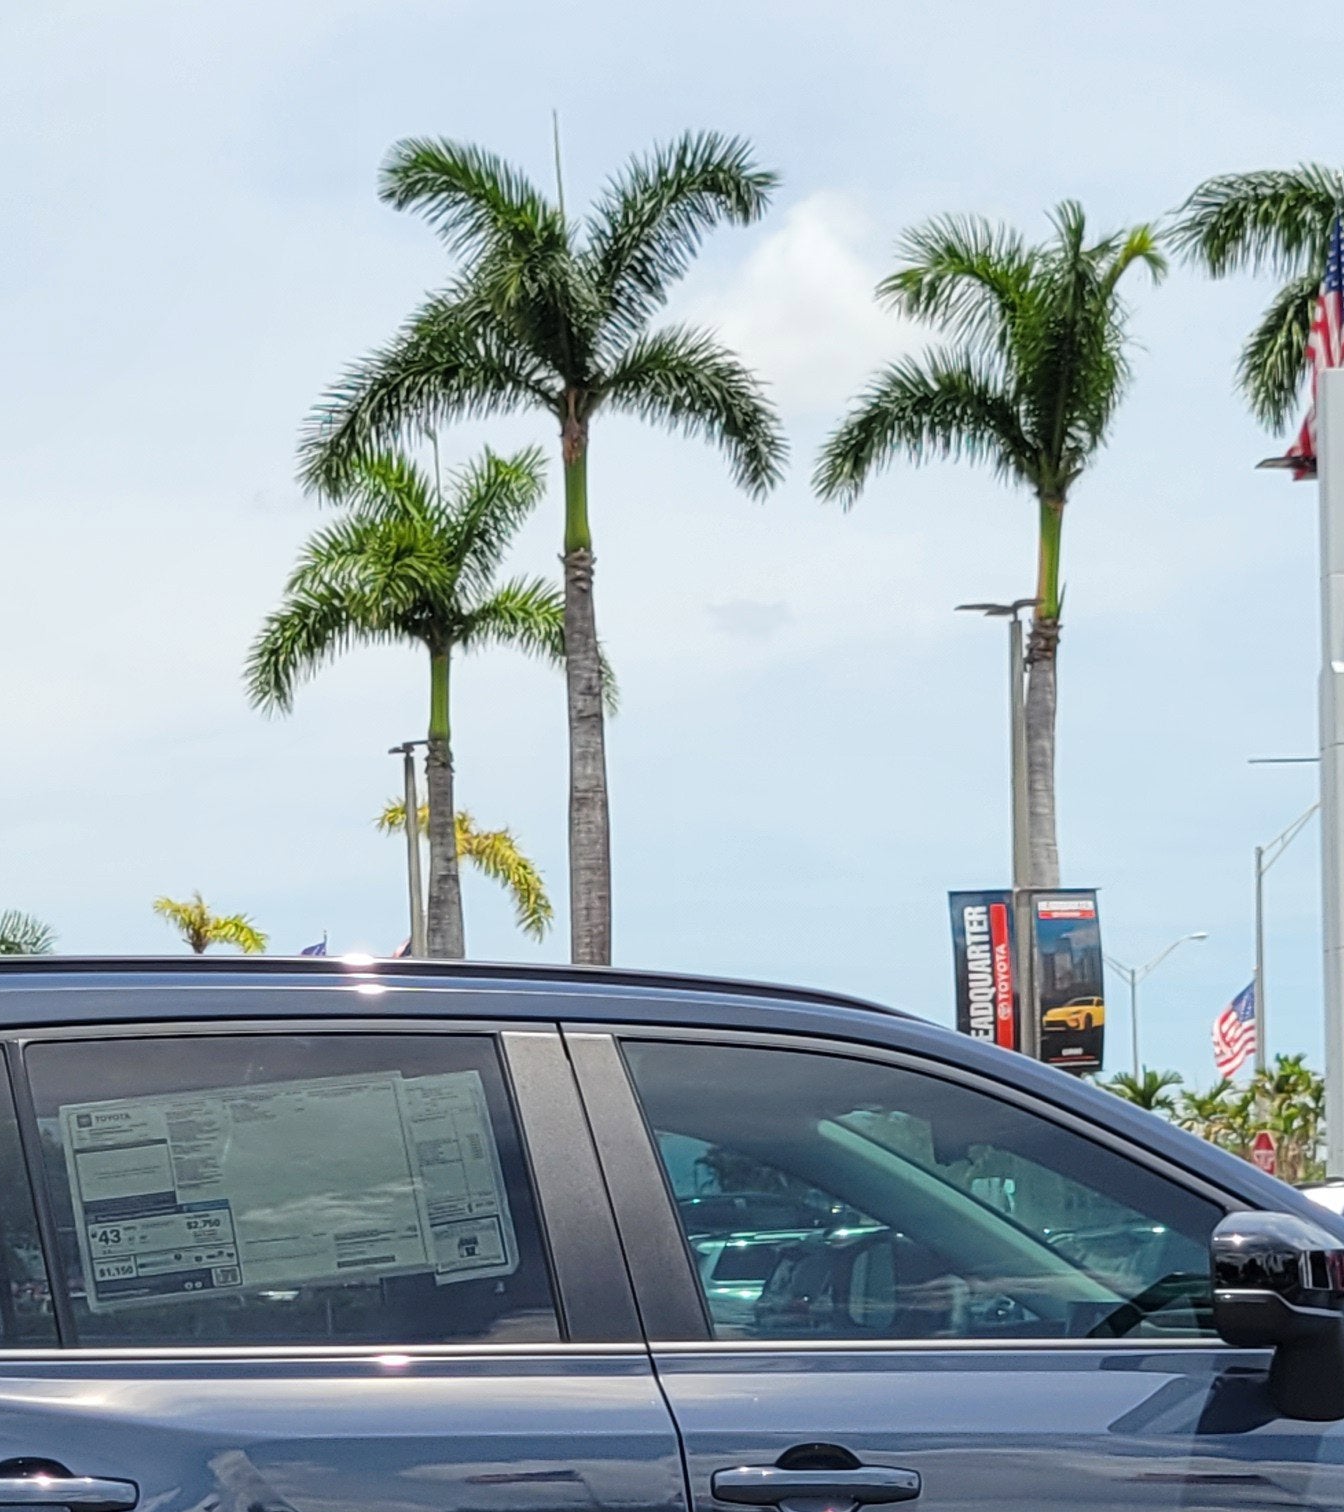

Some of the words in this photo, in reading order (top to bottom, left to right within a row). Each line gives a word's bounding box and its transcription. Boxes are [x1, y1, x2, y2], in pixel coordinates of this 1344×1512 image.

[963, 905, 996, 1044] EADQUARTER
[996, 943, 1011, 1004] TOYOTA
[94, 1112, 131, 1123] TOYOTA
[98, 1228, 122, 1245] 43
